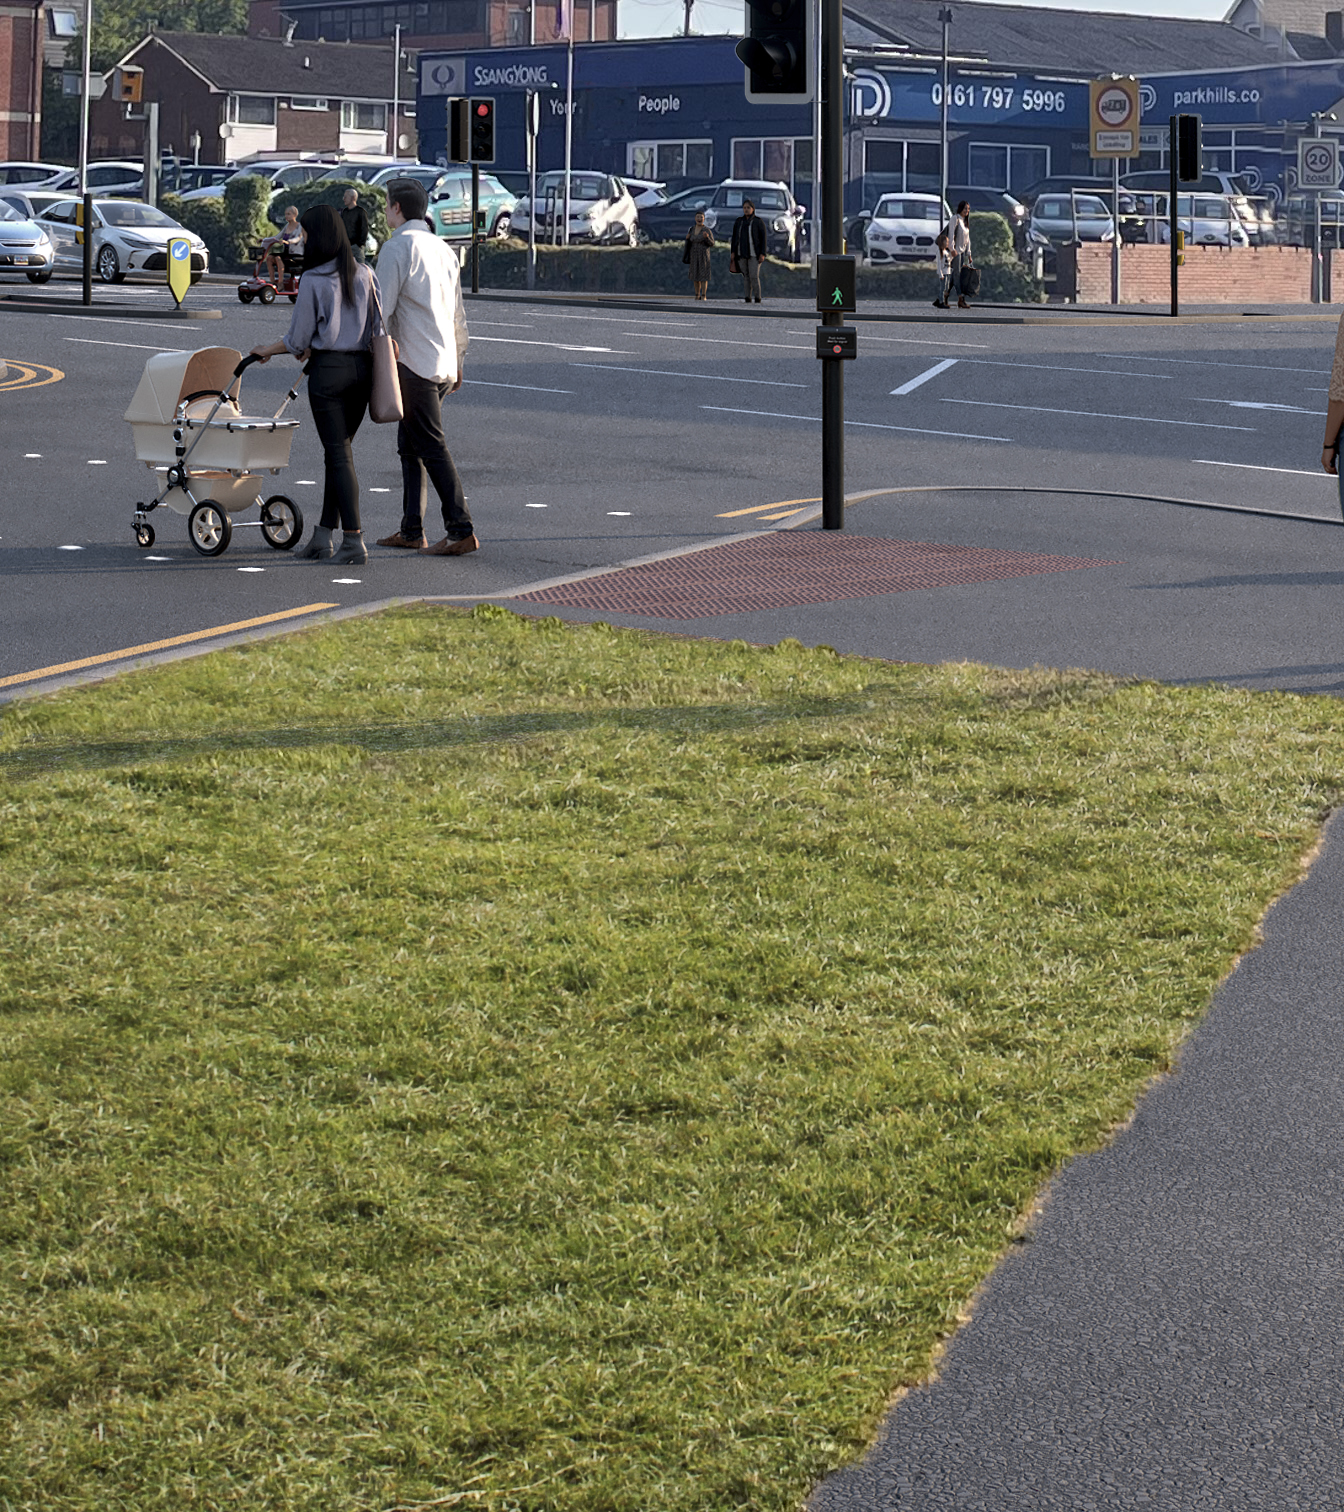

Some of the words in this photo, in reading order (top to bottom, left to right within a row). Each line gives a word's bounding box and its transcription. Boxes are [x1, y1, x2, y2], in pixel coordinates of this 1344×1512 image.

[638, 94, 680, 115] People
[932, 83, 975, 107] 0161
[981, 86, 1014, 109] 797
[1022, 89, 1066, 112] 5996
[1308, 153, 1329, 165] 20
[1305, 174, 1331, 183] ZONE
